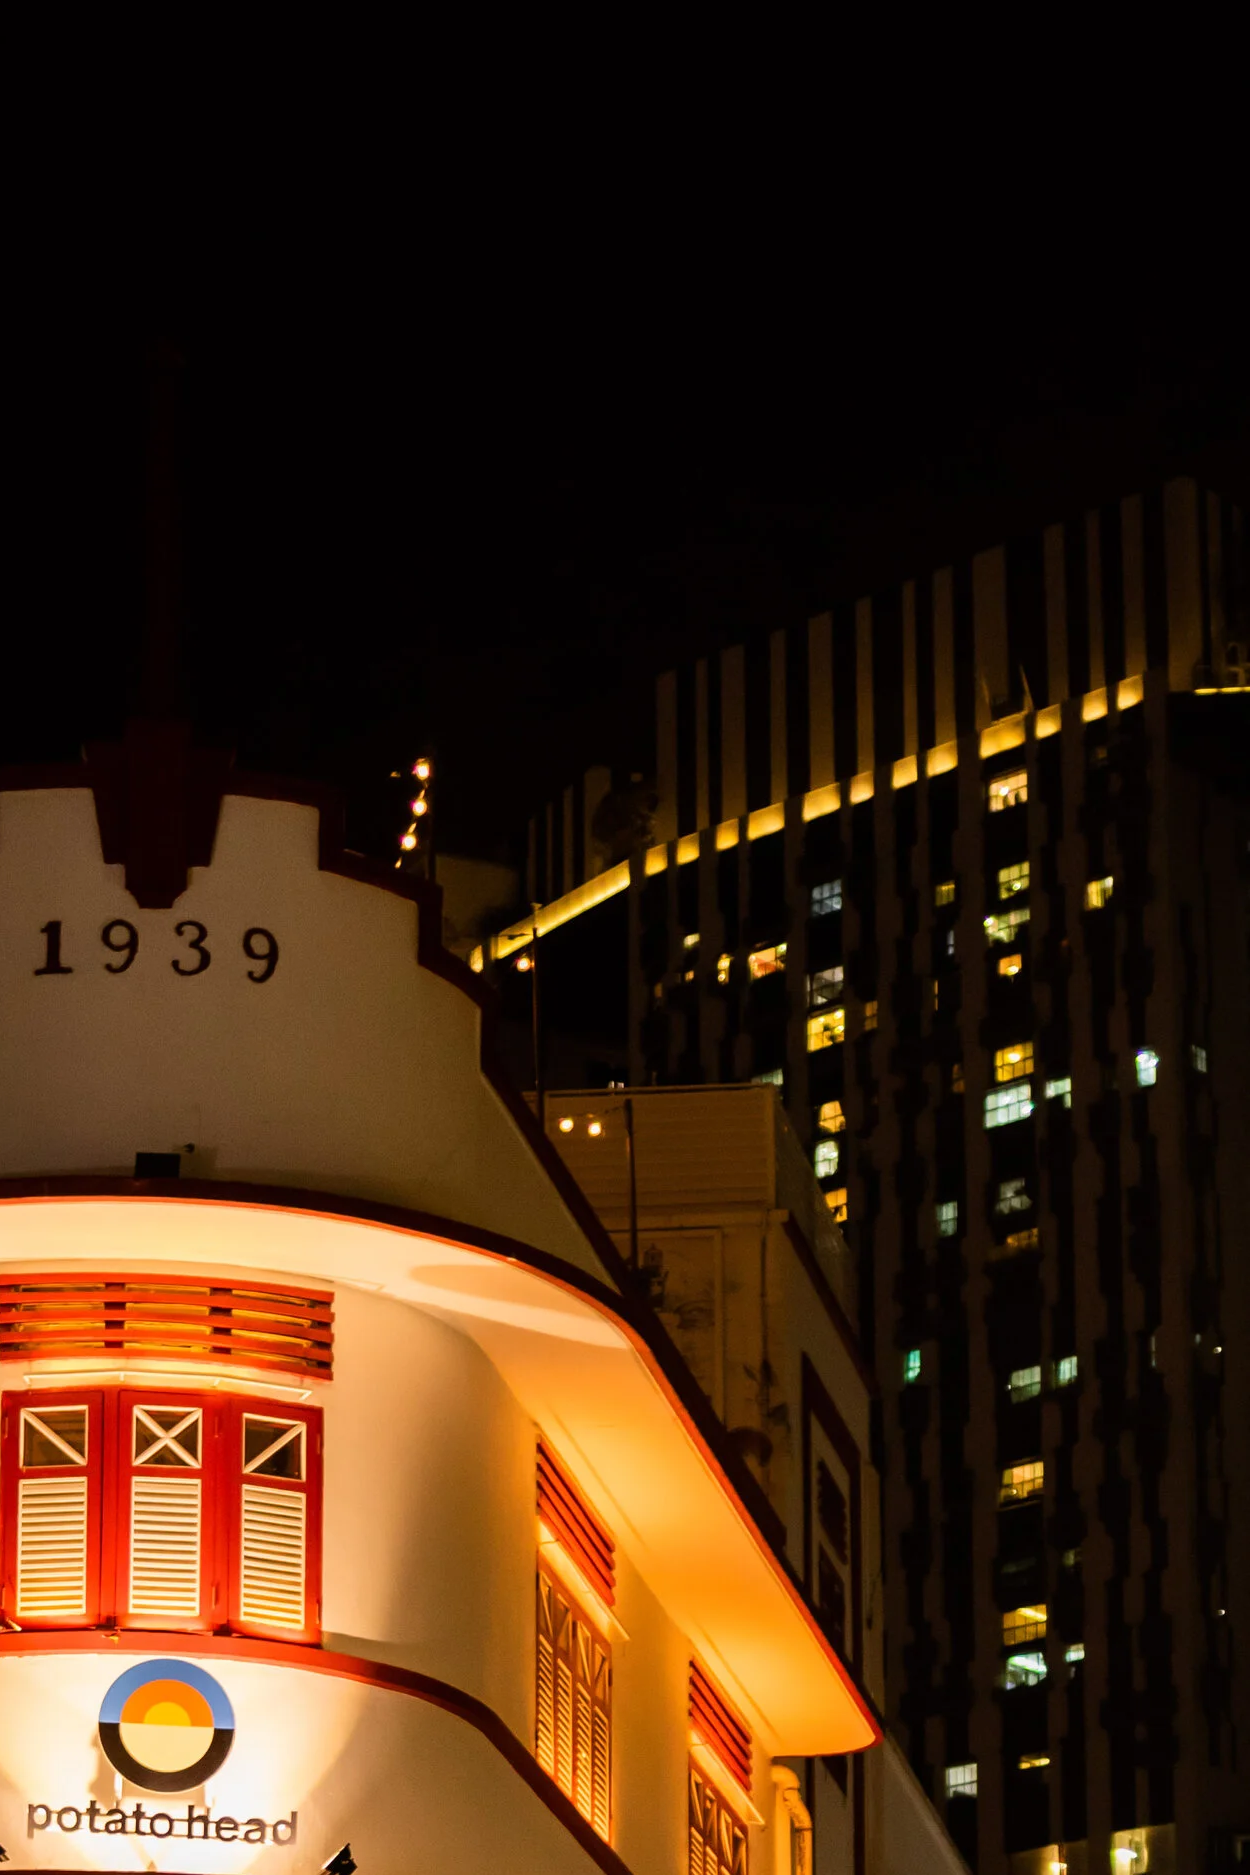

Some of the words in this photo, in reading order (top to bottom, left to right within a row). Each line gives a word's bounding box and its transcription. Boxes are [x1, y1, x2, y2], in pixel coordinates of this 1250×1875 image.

[34, 919, 280, 984] 1939
[26, 1800, 174, 1839] potato
[187, 1804, 298, 1846] head
